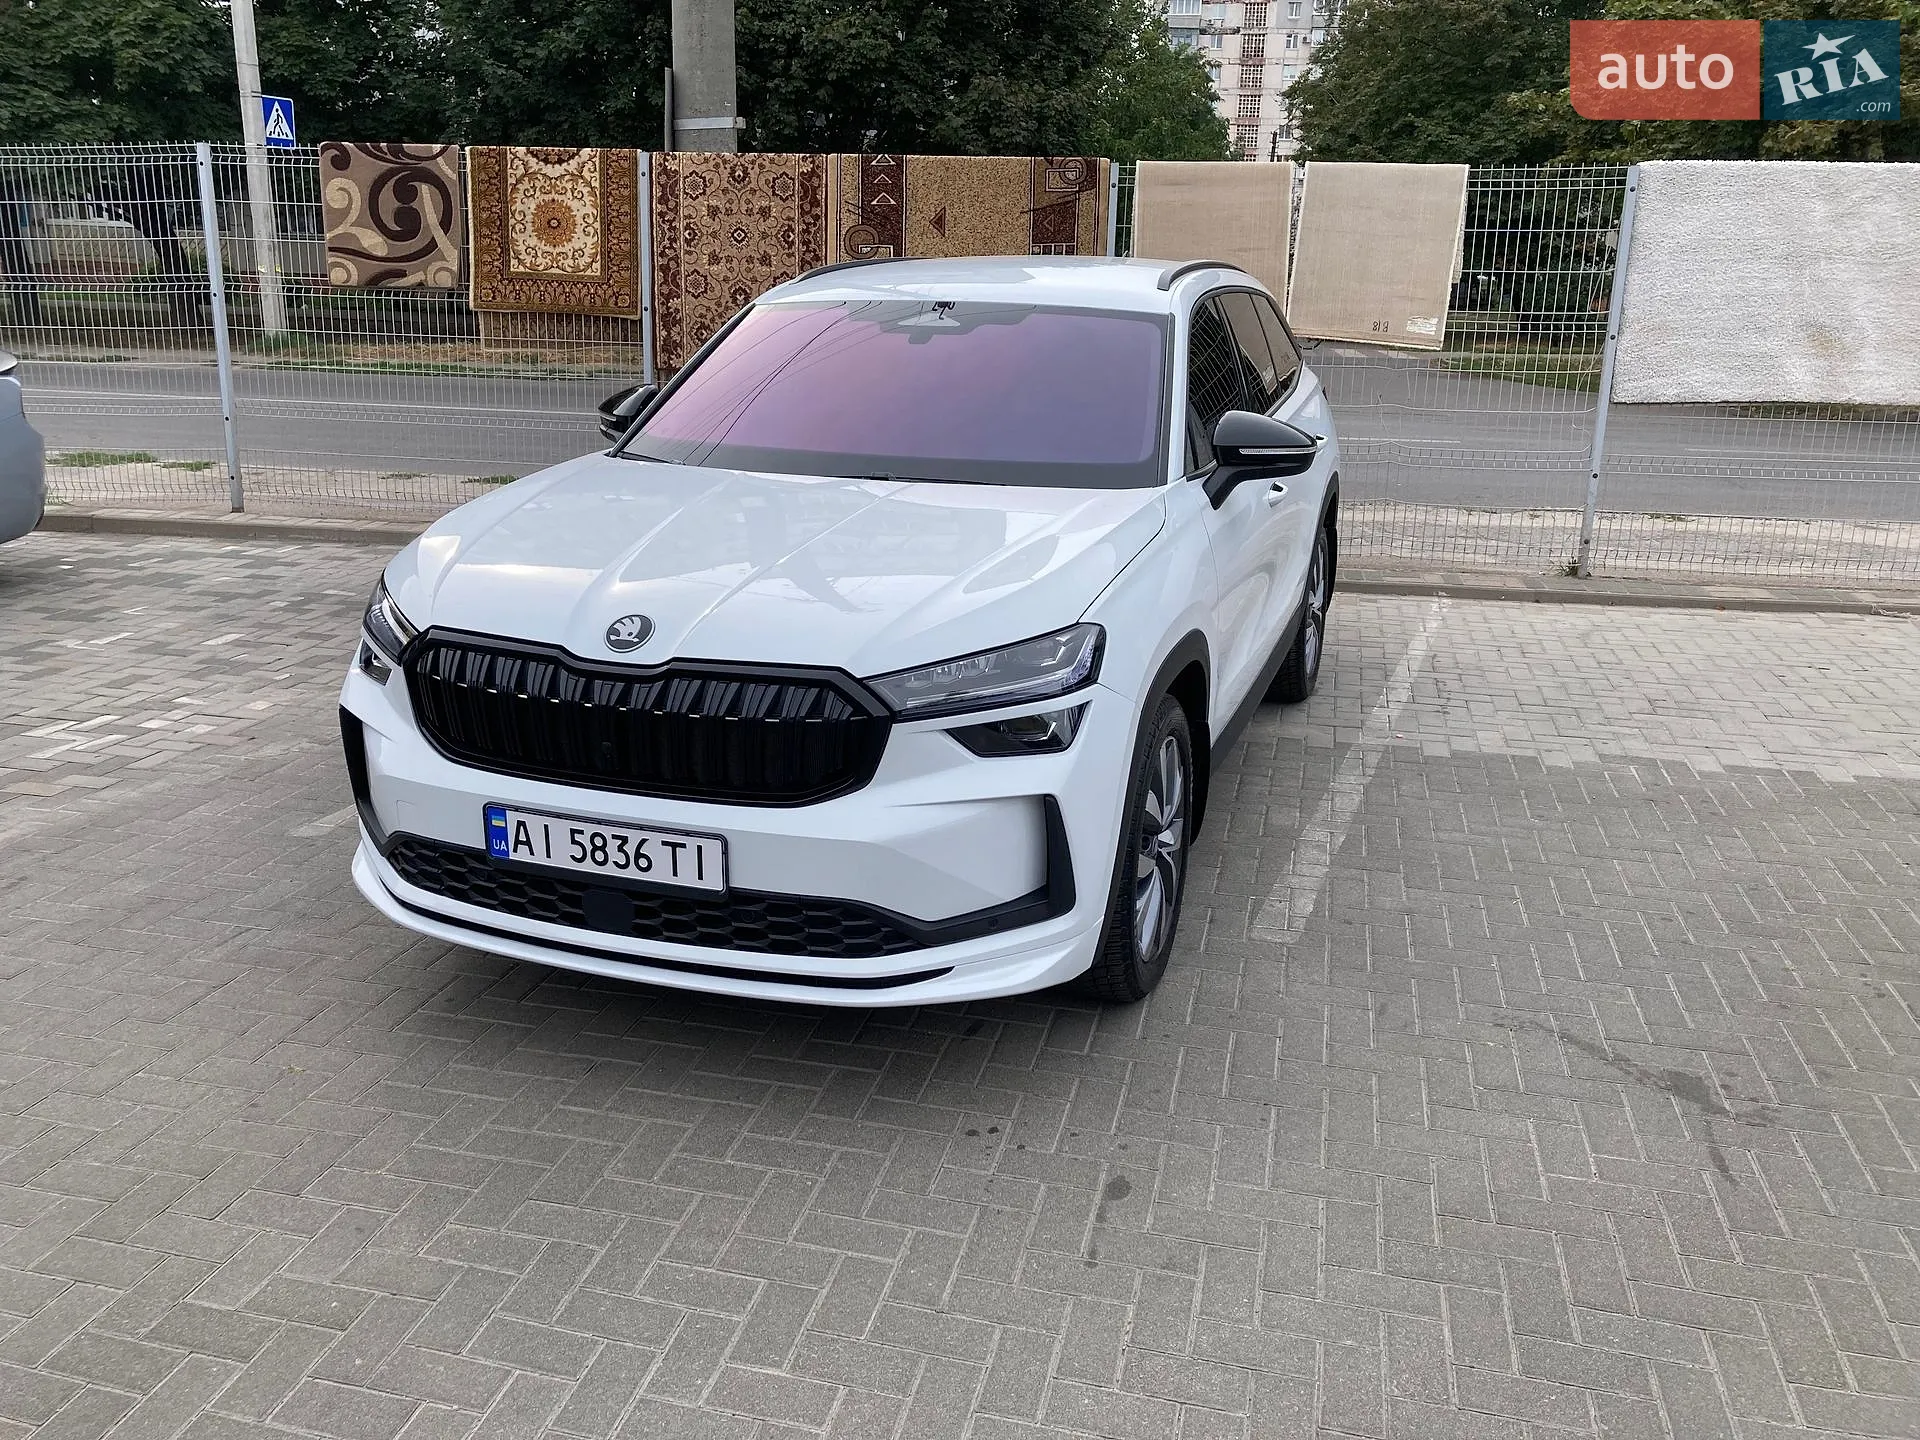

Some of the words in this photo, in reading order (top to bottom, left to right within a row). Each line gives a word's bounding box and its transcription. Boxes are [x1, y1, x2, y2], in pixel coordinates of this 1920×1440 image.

[493, 838, 508, 851] UA
[512, 819, 552, 859] AI
[569, 827, 653, 873] 5836
[660, 840, 704, 881] TI
